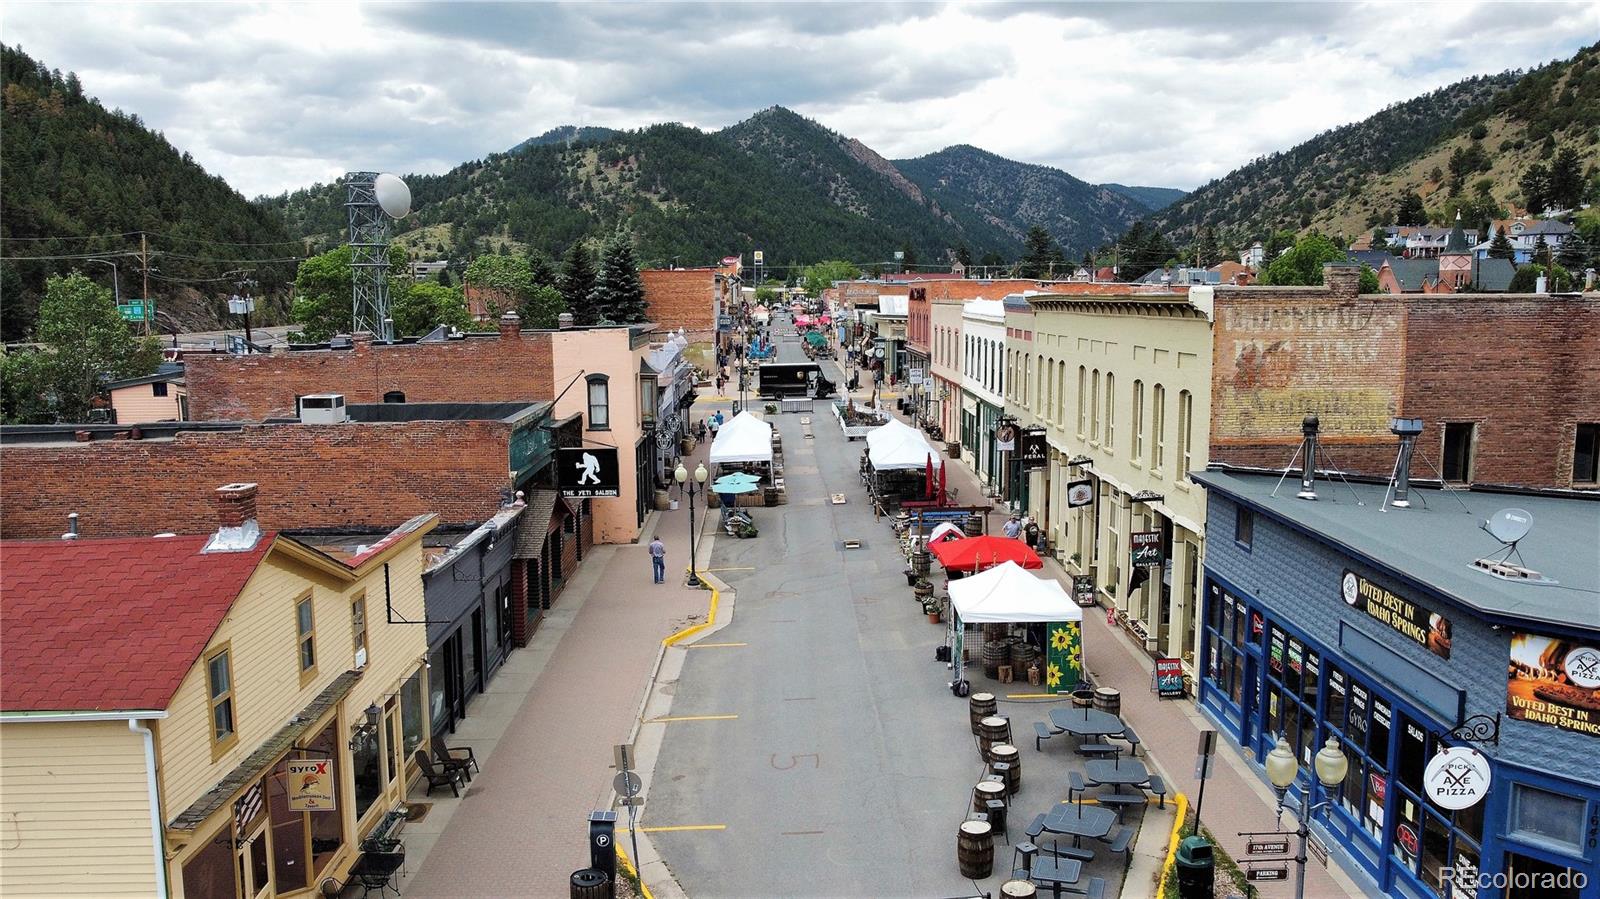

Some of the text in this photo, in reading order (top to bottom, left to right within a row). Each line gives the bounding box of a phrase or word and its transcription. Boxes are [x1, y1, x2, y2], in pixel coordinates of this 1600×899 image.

[1133, 533, 1160, 546] MAJESTIC
[1136, 545, 1158, 559] Art
[1360, 578, 1383, 603] VOTED
[1383, 590, 1404, 614] BEST
[1404, 601, 1415, 621] IN
[1367, 598, 1427, 645] IDAHO SPRINGS
[1157, 662, 1181, 674] MAJESTIC
[1161, 673, 1180, 686] Art
[1571, 670, 1600, 681] PIZZA
[1512, 695, 1589, 721] VOTED BEST IN
[1349, 708, 1368, 733] GYRO
[1524, 709, 1600, 735] IDAHO SPRINGS
[290, 763, 327, 774] gyroX
[1436, 787, 1476, 796] PIZZA
